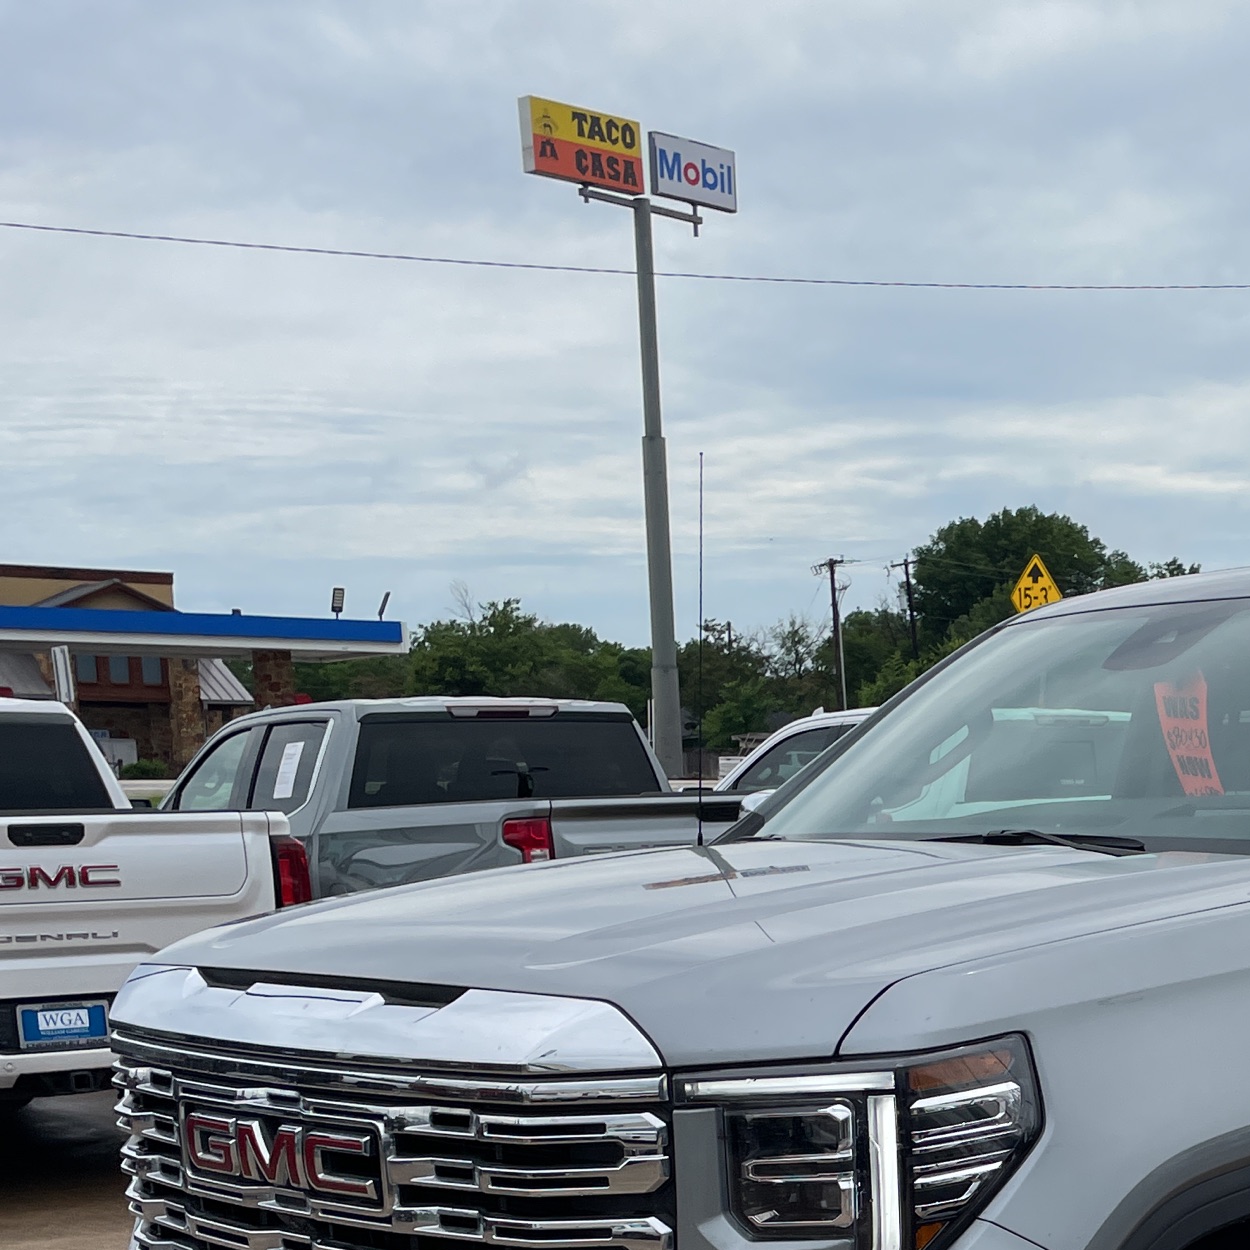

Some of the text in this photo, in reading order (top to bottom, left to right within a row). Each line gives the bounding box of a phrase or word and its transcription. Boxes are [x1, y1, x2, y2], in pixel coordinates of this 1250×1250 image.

[571, 111, 636, 150] TACO
[575, 148, 639, 187] CASA
[658, 148, 733, 195] Mobil
[1162, 695, 1200, 721] WAS
[1176, 754, 1213, 780] NOW
[0, 863, 122, 891] GMC
[42, 1011, 85, 1027] WGA
[186, 1112, 378, 1200] GMC
